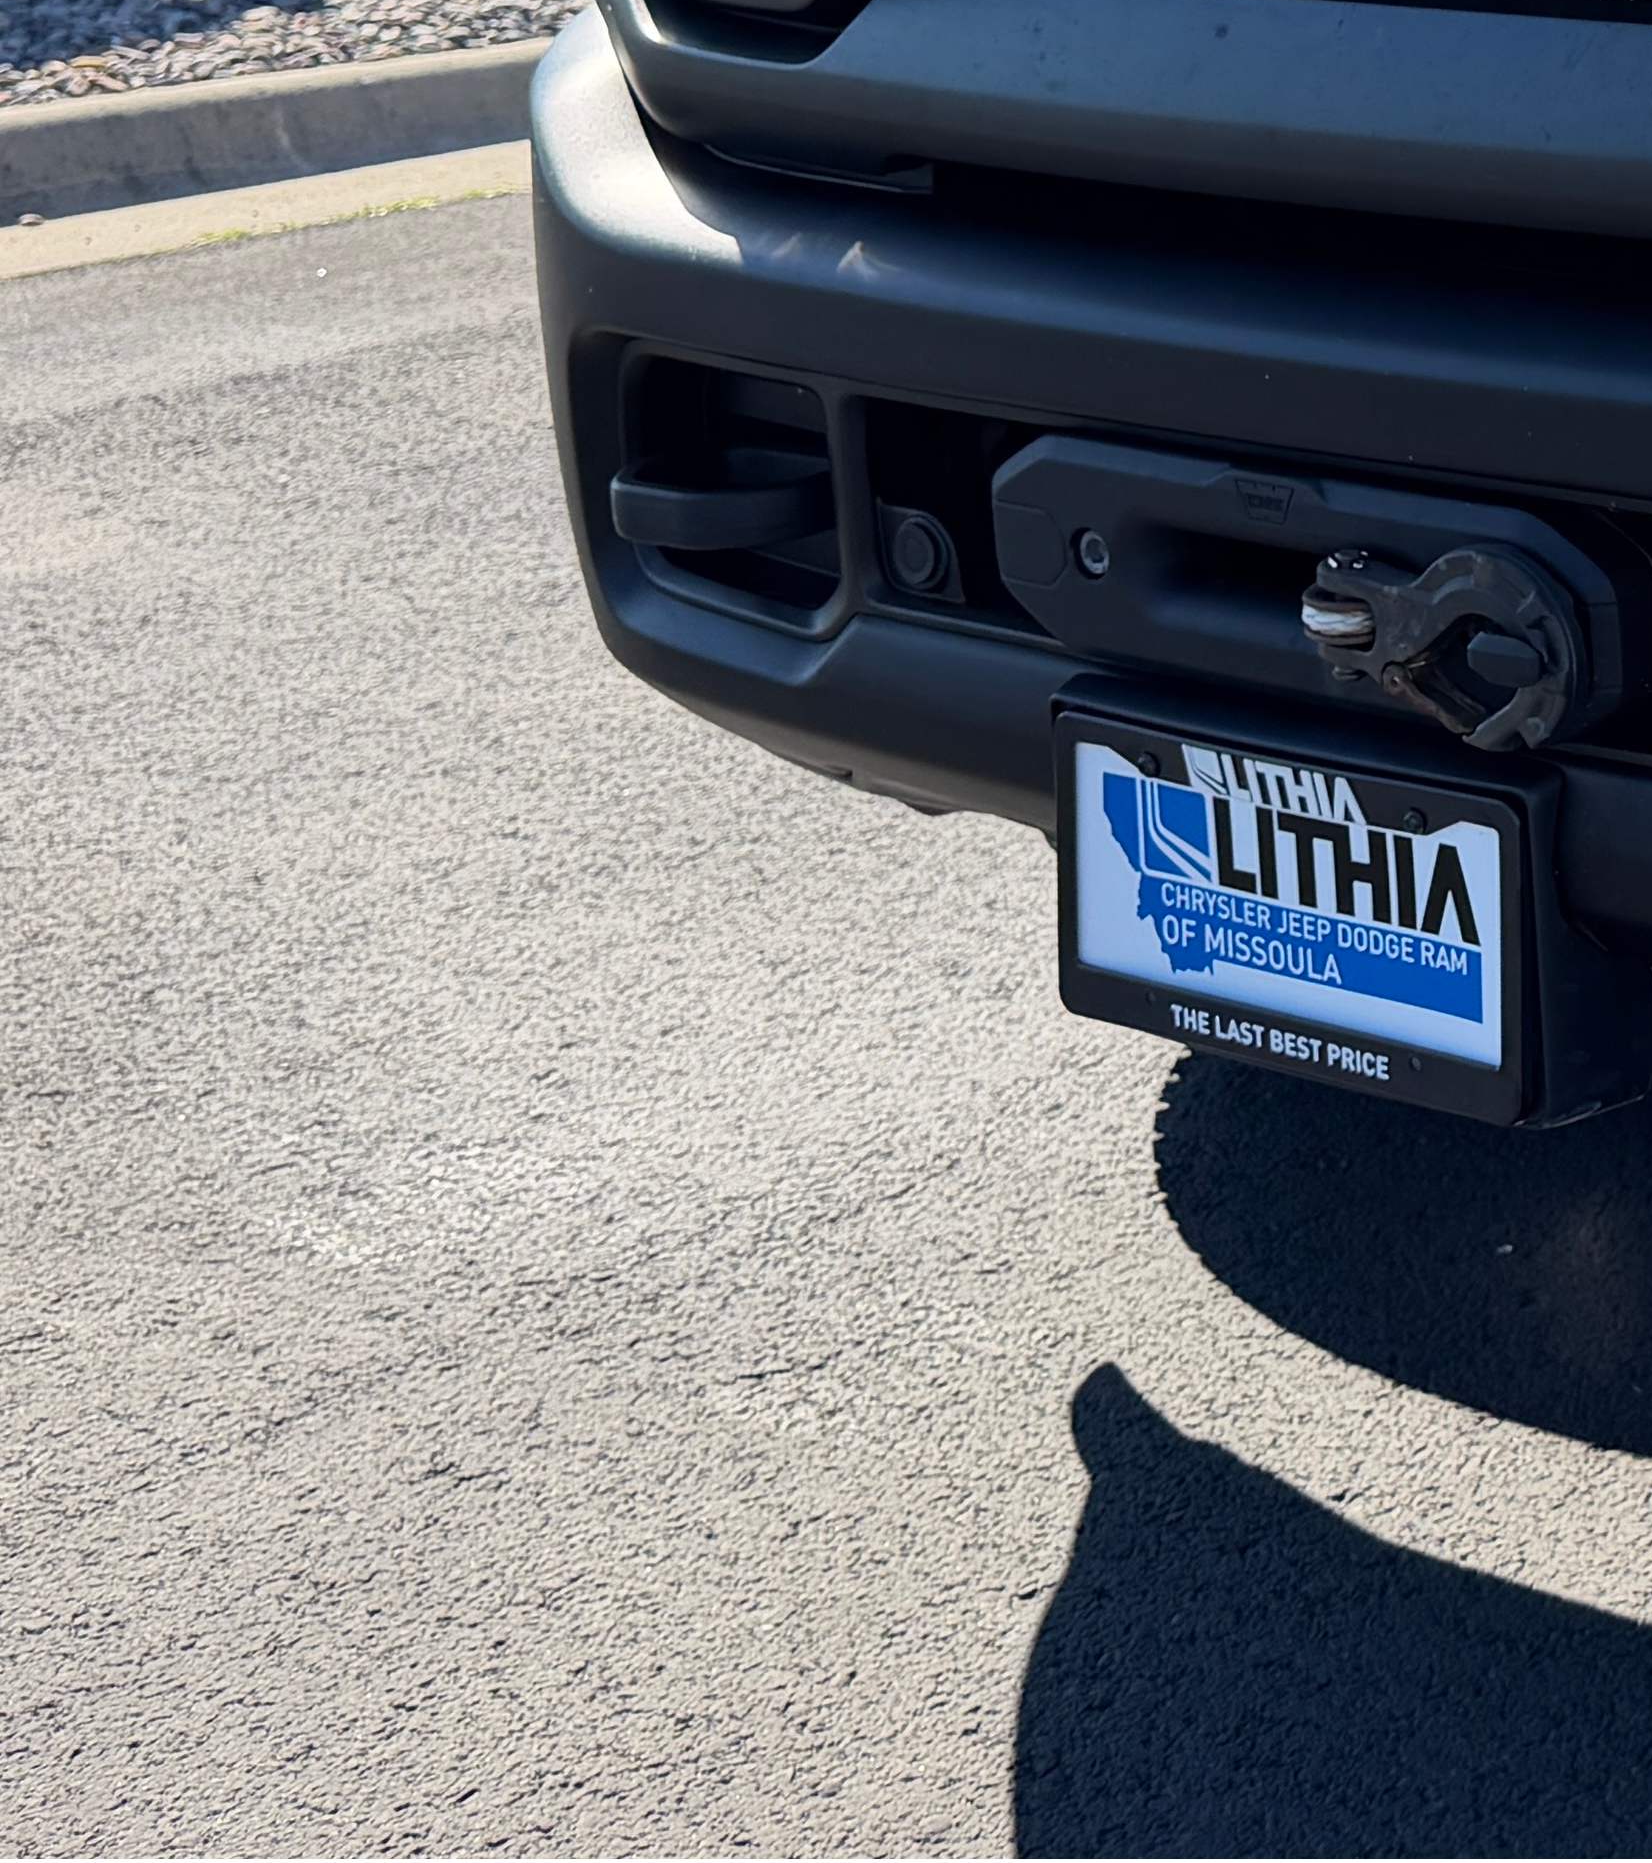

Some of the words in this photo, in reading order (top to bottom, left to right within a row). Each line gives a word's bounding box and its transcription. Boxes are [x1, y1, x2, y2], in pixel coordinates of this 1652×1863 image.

[1219, 753, 1368, 826] LITHIA
[1213, 796, 1482, 947] LITHIA
[1161, 881, 1272, 931] CHRYSLER
[1277, 910, 1332, 944] JEEP
[1338, 922, 1416, 964] DODGE
[1420, 940, 1469, 976] RAM
[1161, 914, 1197, 948] OF
[1203, 926, 1343, 986] MISSOULA
[1170, 1003, 1212, 1037] THE
[1214, 1014, 1265, 1049] LAST
[1270, 1028, 1324, 1064] BEST
[1326, 1042, 1391, 1082] PRICE
